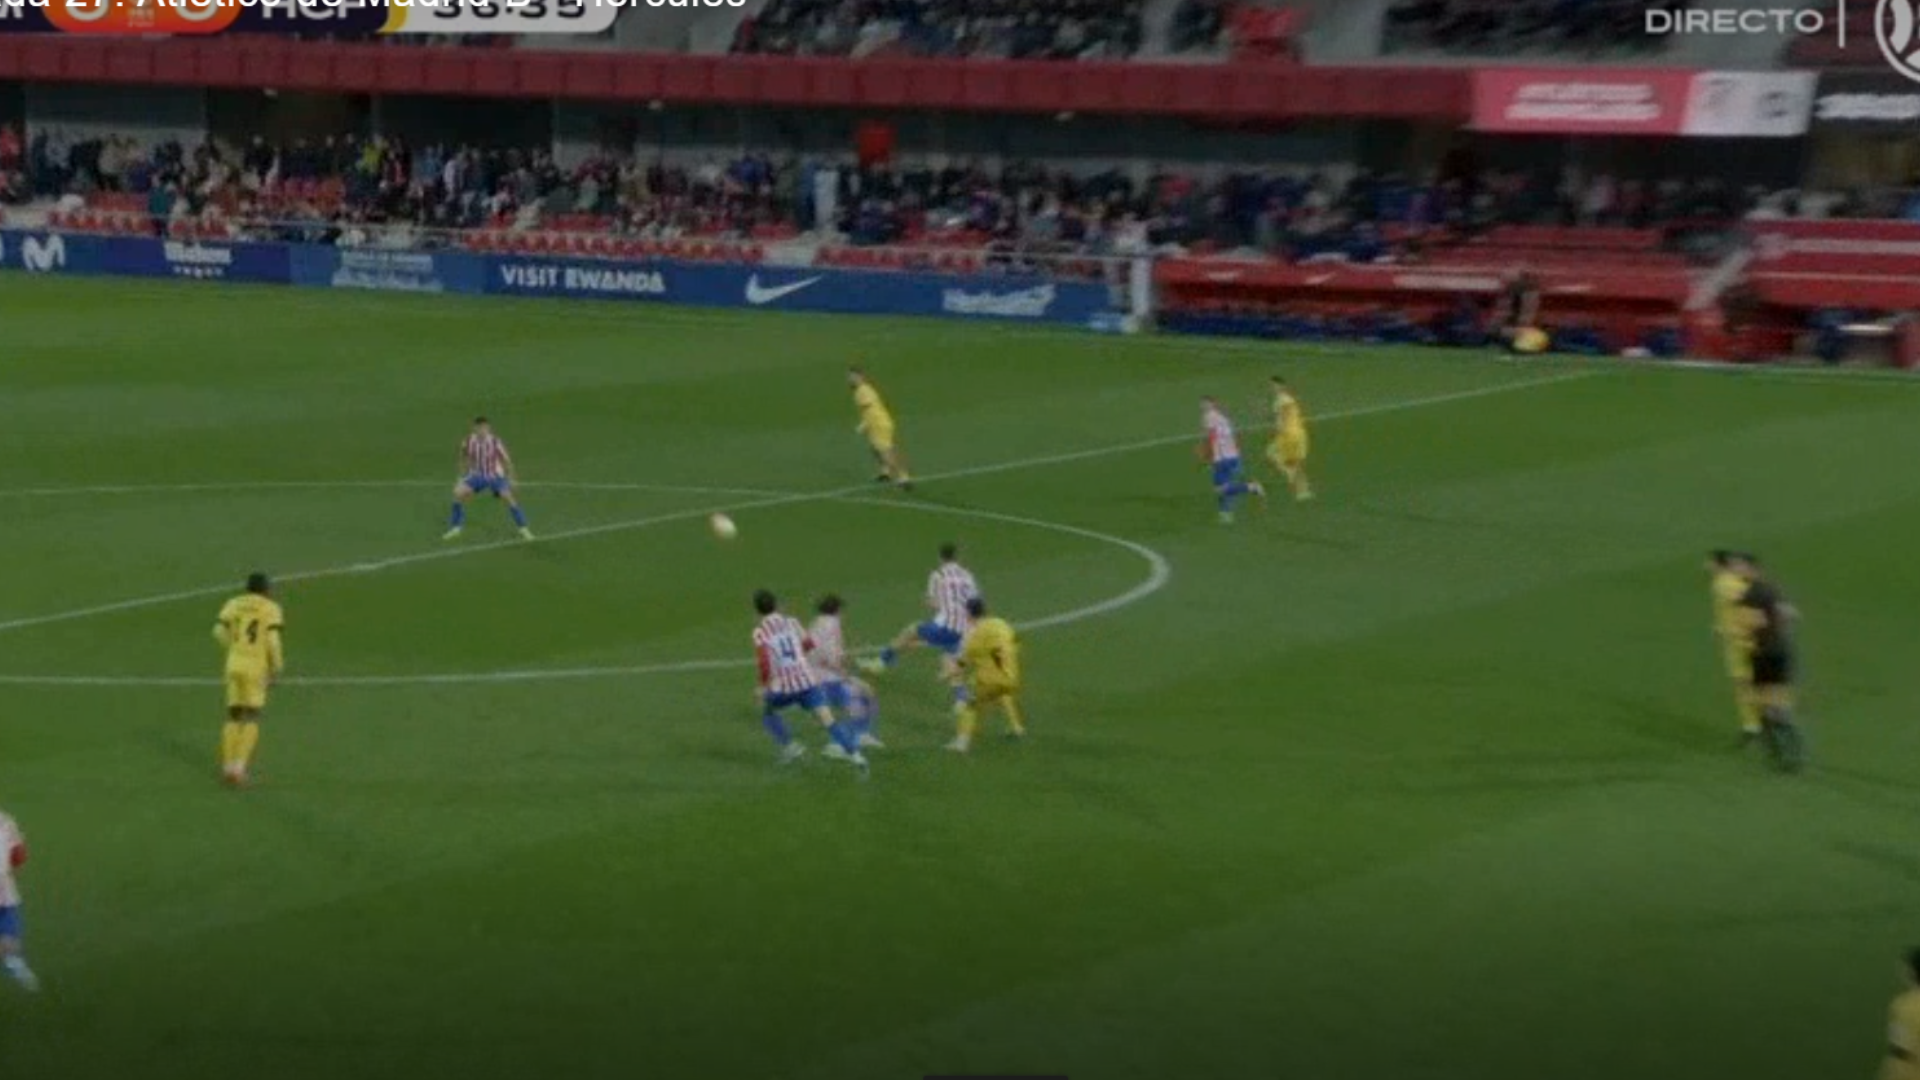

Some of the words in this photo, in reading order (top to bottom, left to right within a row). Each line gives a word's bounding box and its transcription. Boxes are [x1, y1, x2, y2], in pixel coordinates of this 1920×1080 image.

[500, 264, 558, 287] VISIT
[565, 267, 666, 292] RWANDA
[777, 637, 796, 660] 4
